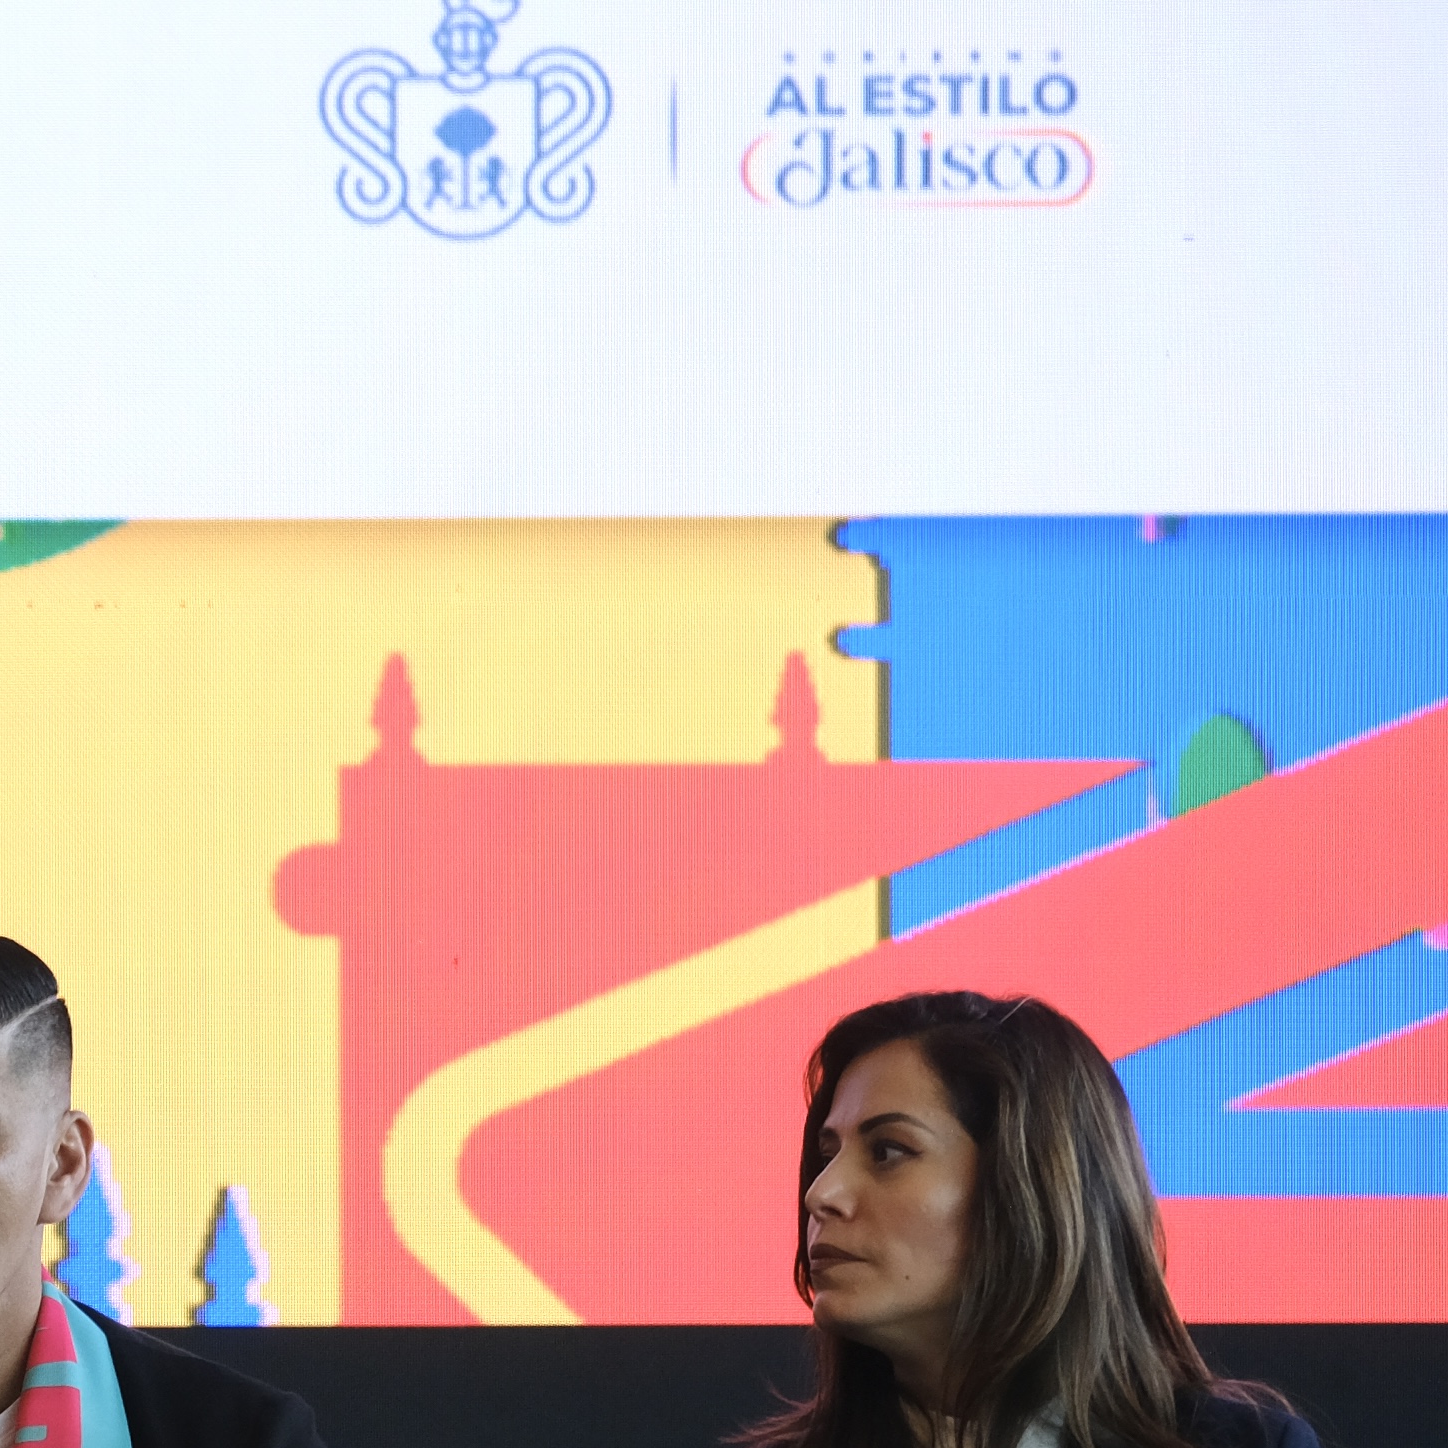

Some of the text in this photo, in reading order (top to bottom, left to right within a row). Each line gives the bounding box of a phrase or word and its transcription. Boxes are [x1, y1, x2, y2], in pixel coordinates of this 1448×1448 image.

[766, 73, 1079, 117] AL ESTILO
[775, 127, 1071, 208] Jalisco
